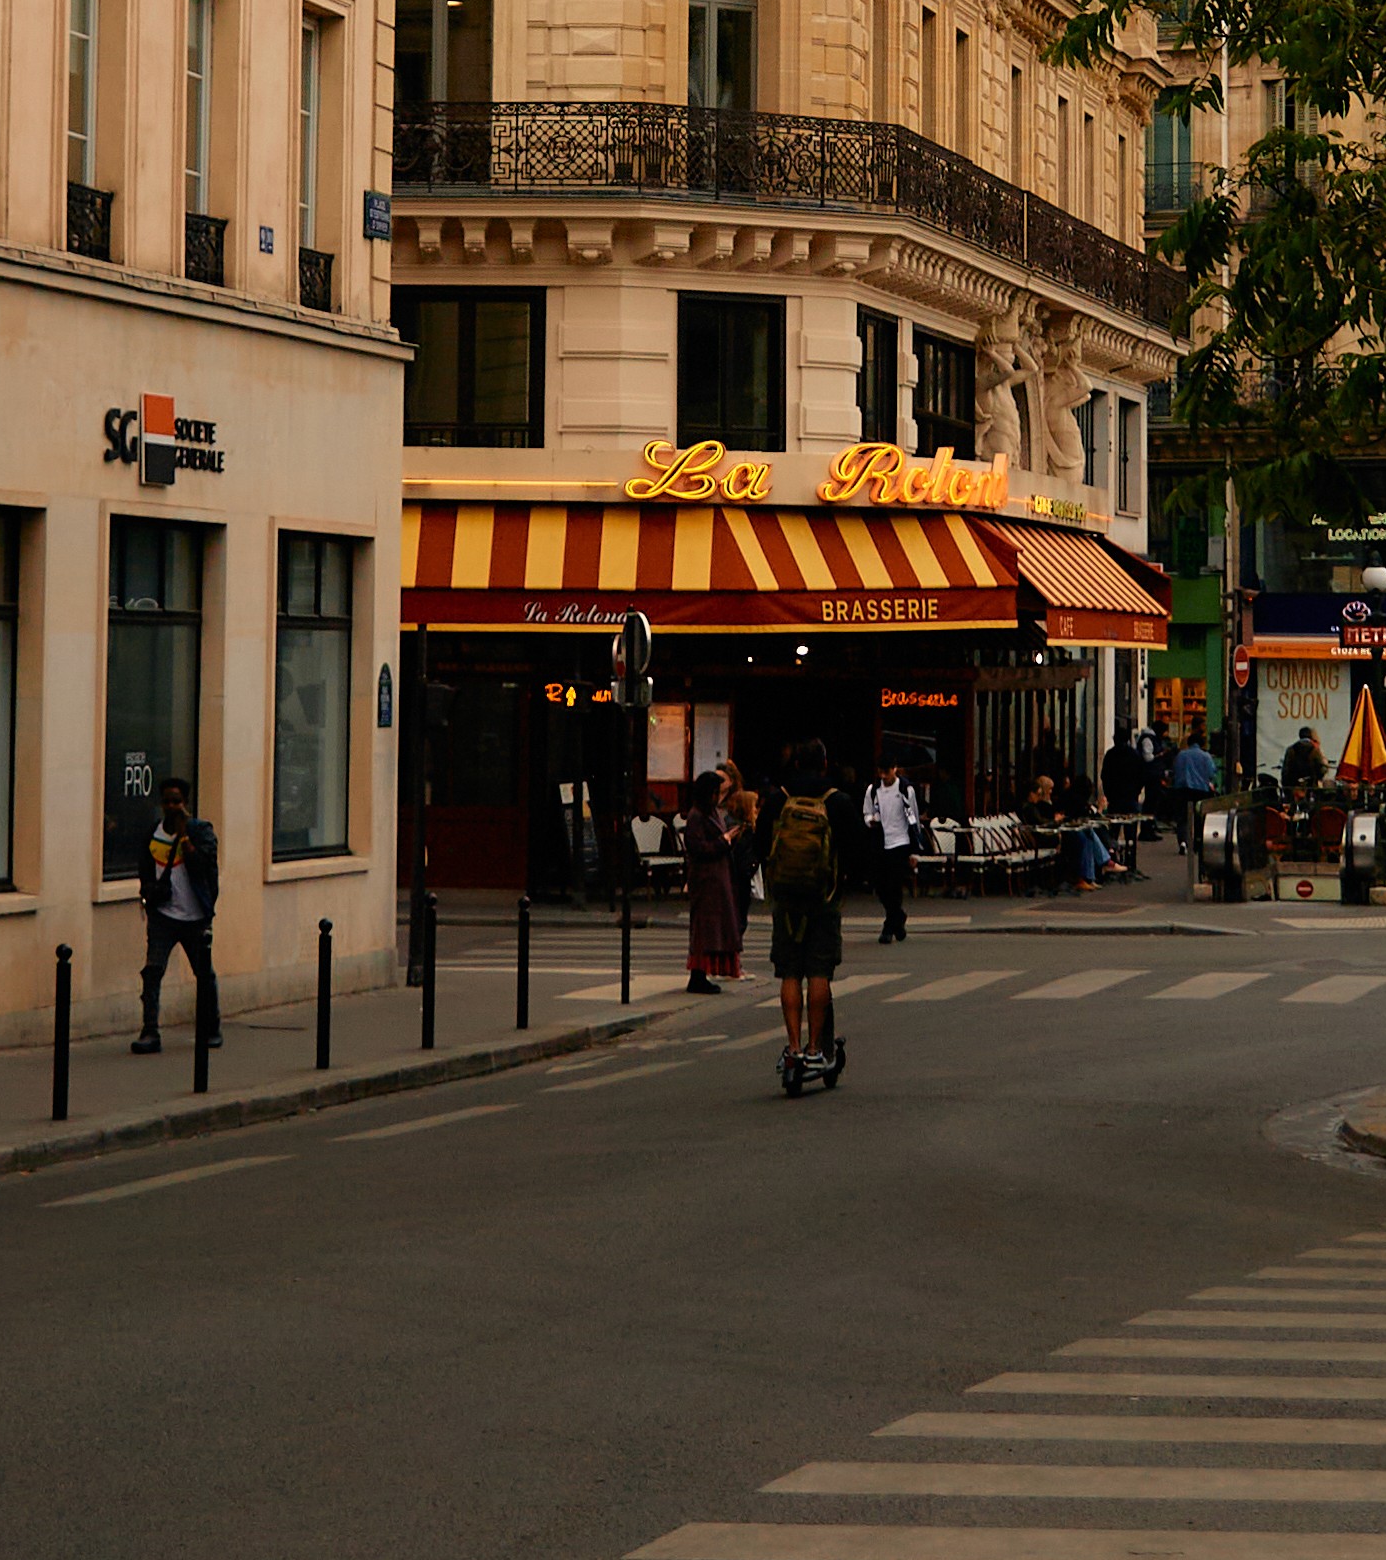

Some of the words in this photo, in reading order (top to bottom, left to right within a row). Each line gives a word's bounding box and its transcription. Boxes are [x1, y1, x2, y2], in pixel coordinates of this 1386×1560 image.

[103, 407, 138, 464] SG
[624, 439, 774, 501] La
[524, 600, 549, 624] La
[821, 598, 939, 622] BRASSERIE
[1266, 661, 1340, 692] COMING
[1277, 691, 1328, 720] SOON
[124, 765, 153, 798] PRO
